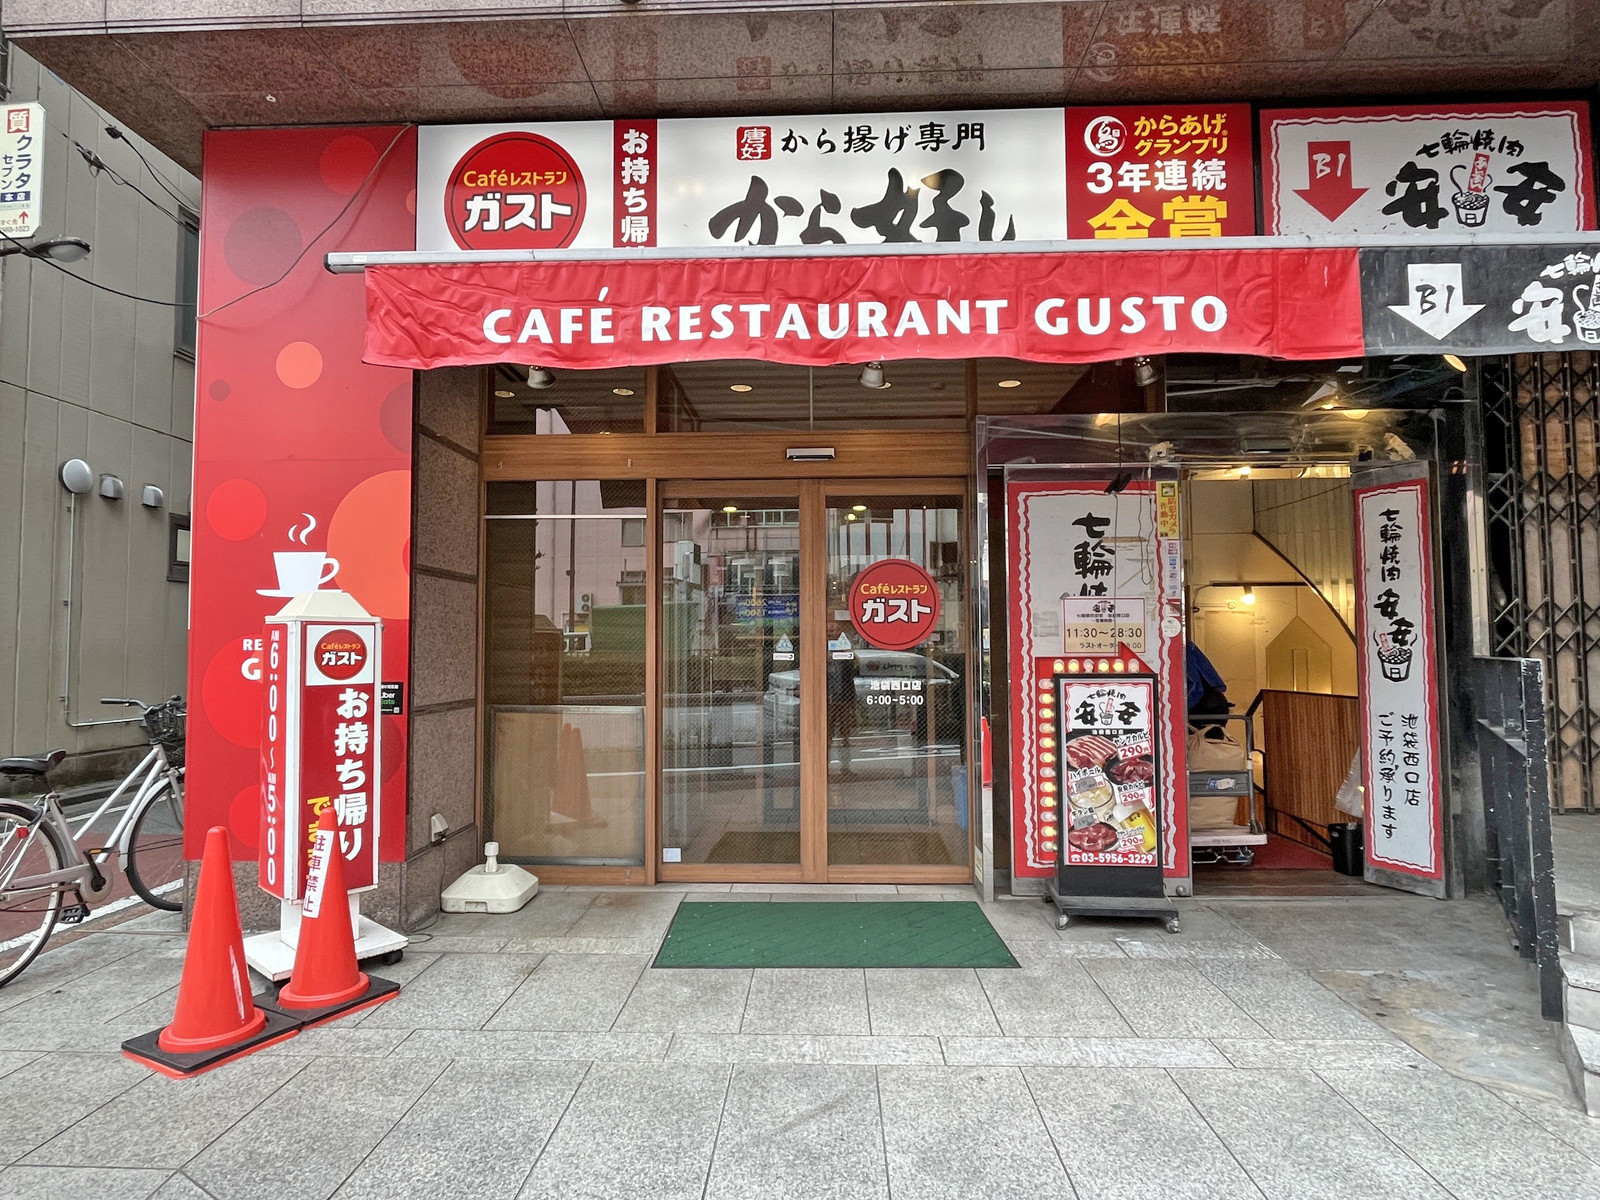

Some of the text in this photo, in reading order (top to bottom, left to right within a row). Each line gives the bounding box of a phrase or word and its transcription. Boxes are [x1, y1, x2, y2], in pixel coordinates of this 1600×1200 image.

[781, 122, 985, 155] から揚げ専門
[1134, 113, 1227, 136] からあげ
[1134, 137, 1228, 157] グランプリ
[1416, 129, 1524, 158] 七輪焼肉
[2, 154, 14, 190] セブン
[16, 135, 32, 189] クラタ
[1086, 158, 1227, 194] 3年連続
[1312, 153, 1347, 179] B1
[621, 128, 650, 248] お持ち帰
[464, 192, 572, 231] ガスト
[1087, 195, 1228, 240] 金賞
[483, 287, 1228, 345] CAFÉ RESTAURANT GUSTO
[1416, 284, 1455, 315] B1
[1379, 508, 1403, 582] 七輪焼肉
[861, 597, 931, 623] ガスト
[321, 651, 363, 666] ガスト
[870, 680, 922, 691] 池袋西口店
[334, 687, 370, 861] お持ち帰り
[1378, 711, 1400, 839] ご予約承ります
[1401, 713, 1422, 806] 池袋西口店
[1081, 852, 1153, 865] 03-5956-3229
